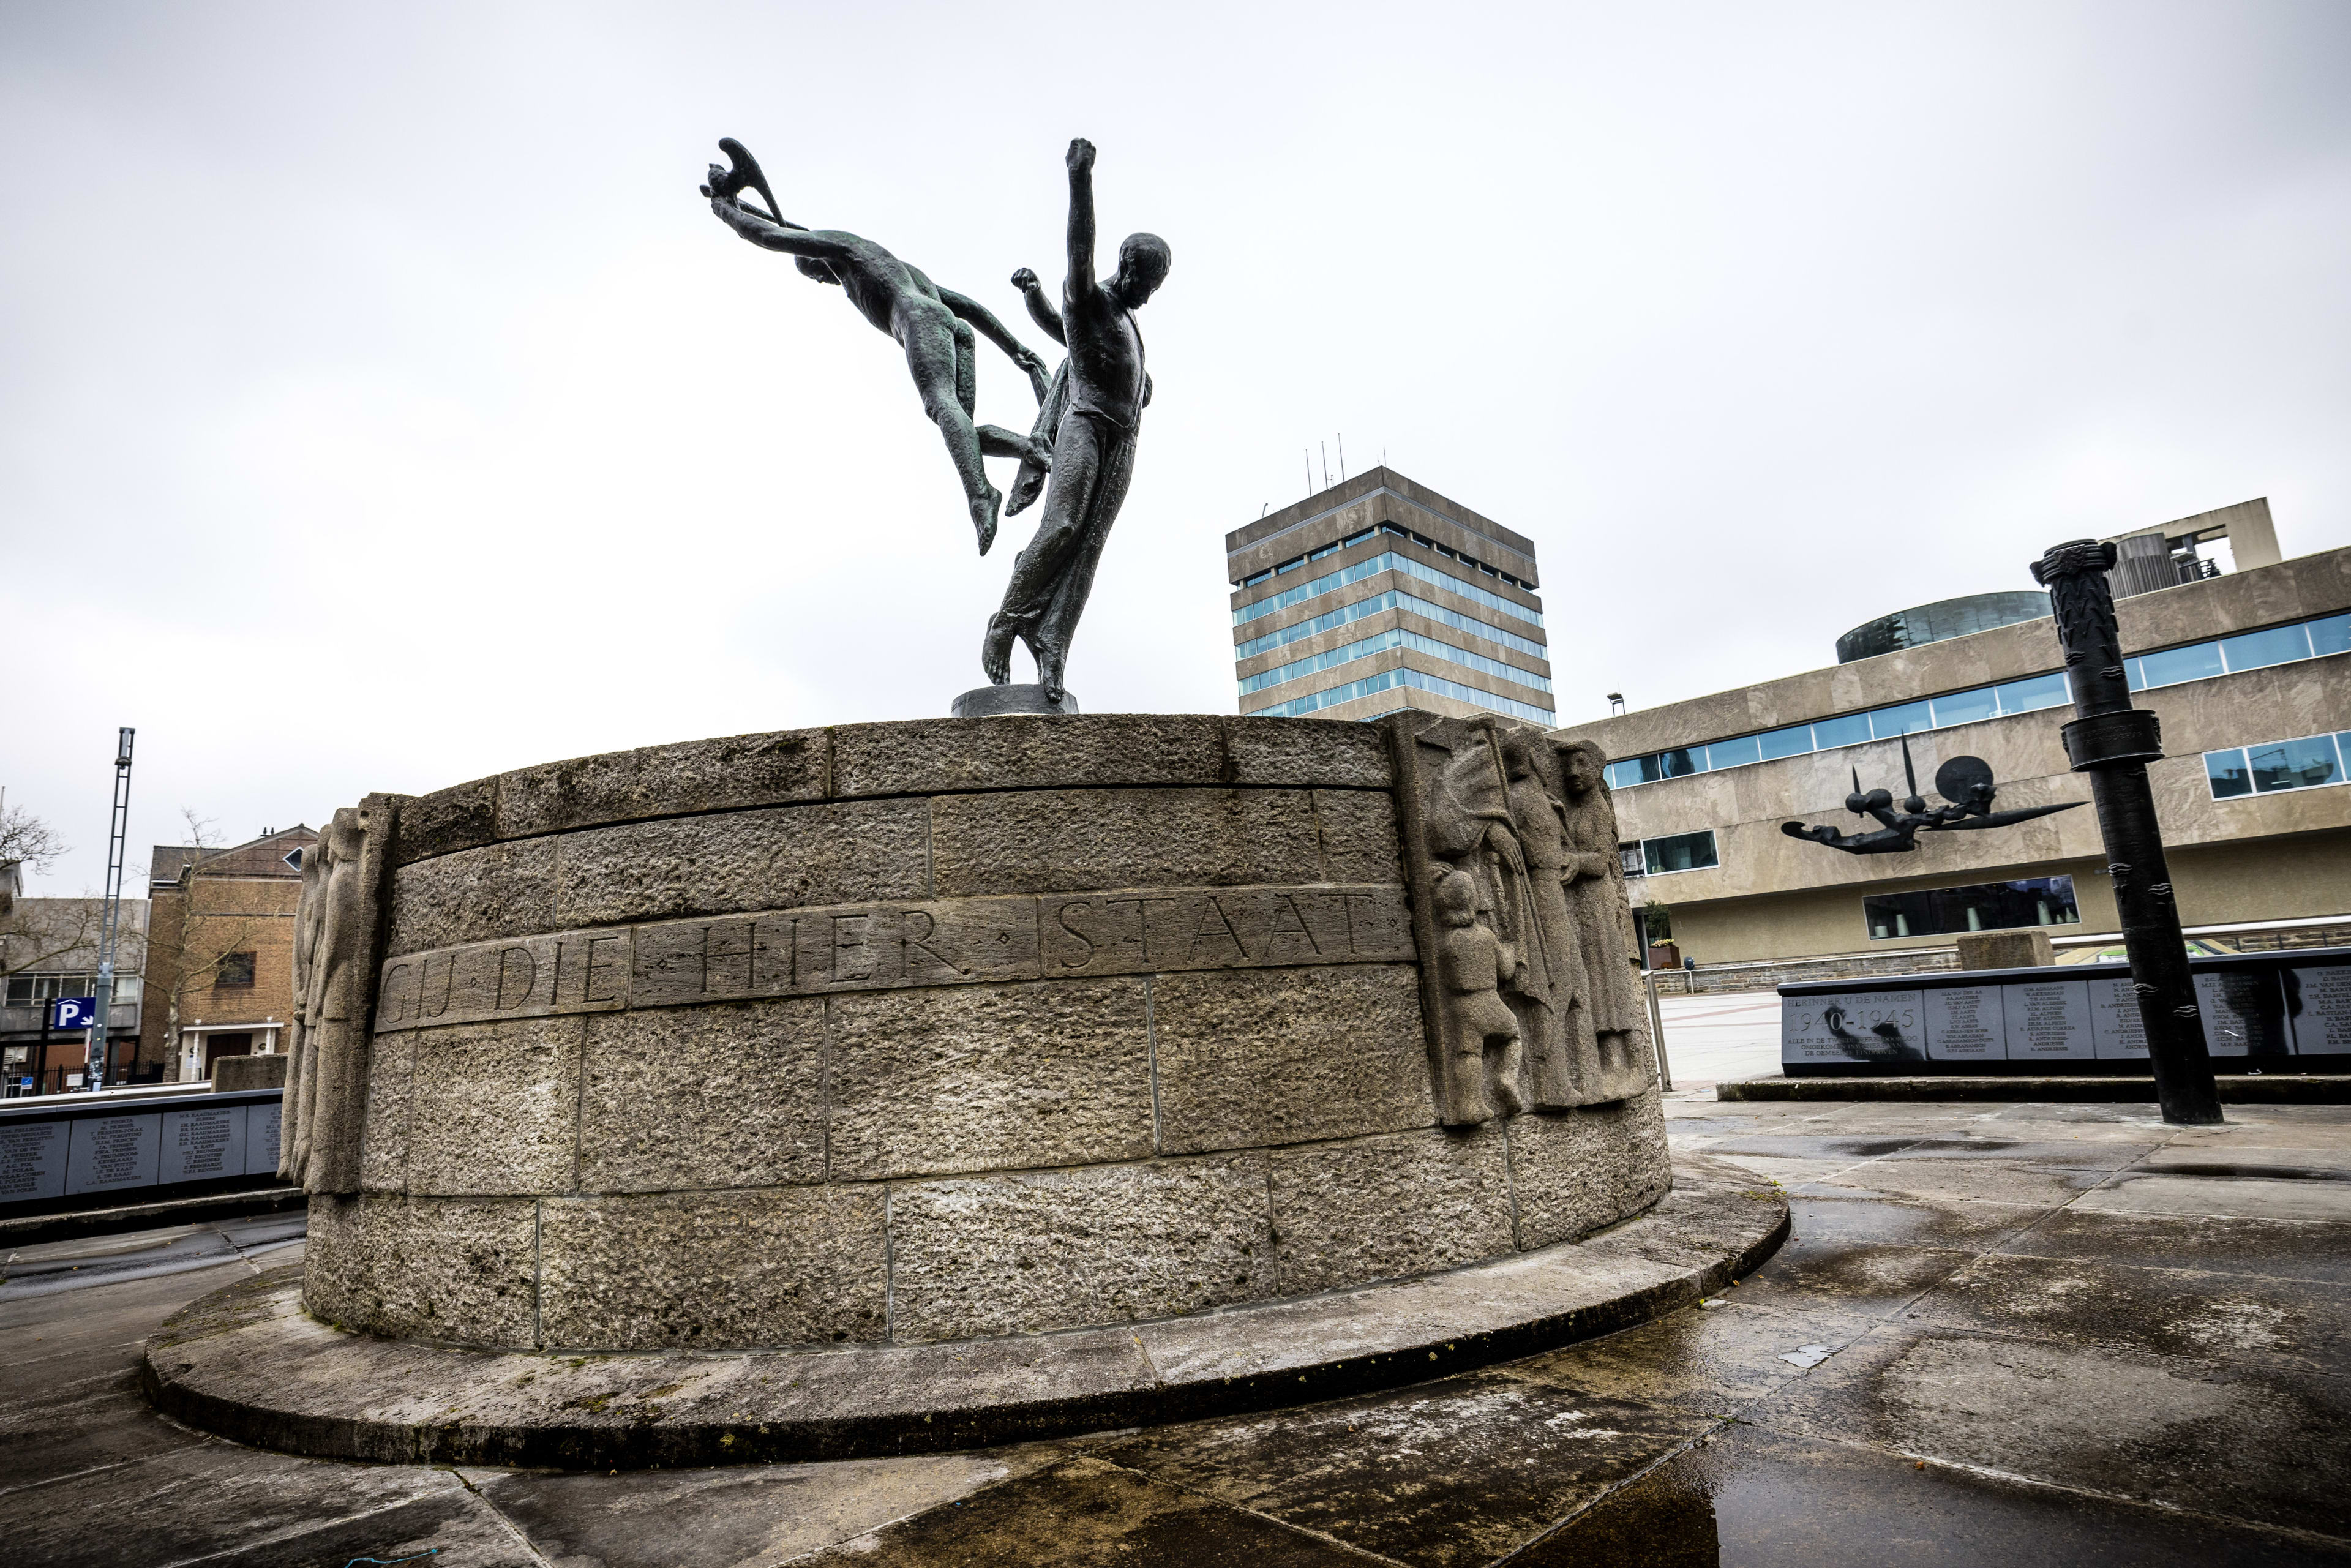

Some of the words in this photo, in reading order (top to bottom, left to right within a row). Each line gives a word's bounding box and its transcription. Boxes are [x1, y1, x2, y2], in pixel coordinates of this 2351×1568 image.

[381, 954, 457, 1024] GIJ
[493, 936, 618, 1011] DIE
[700, 909, 967, 993] HIER
[1059, 894, 1373, 969] STAAT
[1788, 999, 1841, 1007] HERINNER
[1874, 994, 1915, 1003] NAMEN
[59, 1003, 80, 1026] P
[1789, 1009, 1914, 1032] 1940-1945
